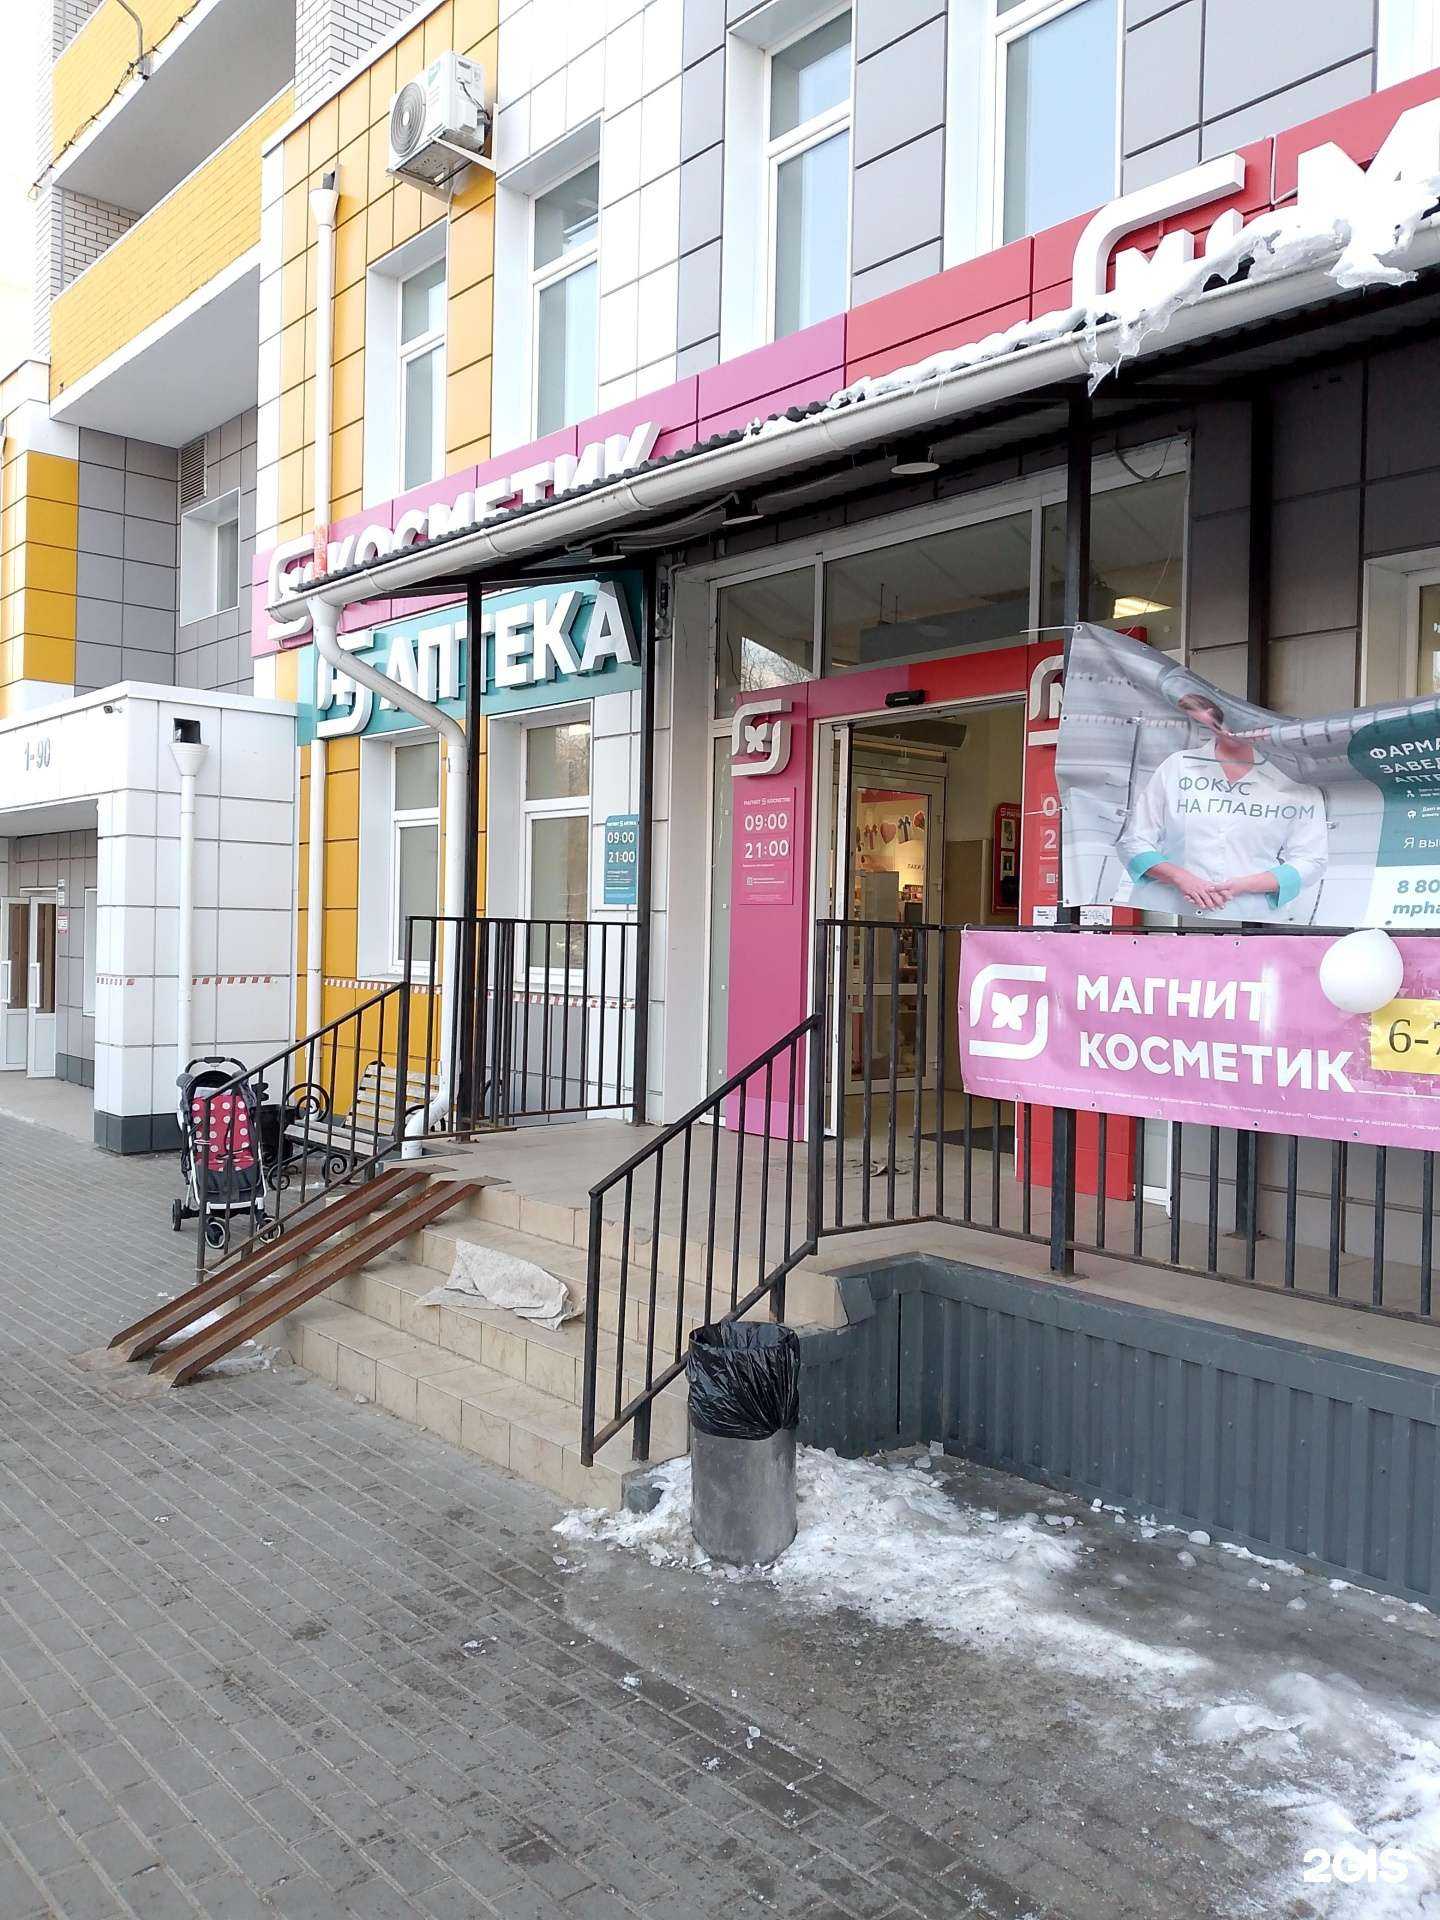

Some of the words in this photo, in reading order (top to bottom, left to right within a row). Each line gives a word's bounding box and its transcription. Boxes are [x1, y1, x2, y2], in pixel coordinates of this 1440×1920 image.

[379, 580, 640, 711] АПТЕКА
[25, 737, 50, 771] 1-90
[1178, 776, 1256, 796] ФОКУС
[1176, 798, 1201, 813] НА
[1207, 799, 1315, 819] ГЛАВНОМ
[744, 813, 787, 831] 09:00
[607, 831, 635, 844] 09:00
[1403, 836, 1415, 849] Я
[1419, 839, 1440, 849] вы
[608, 851, 636, 863] 21:00
[744, 840, 789, 859] 21:00
[1397, 880, 1409, 894] 8
[1077, 974, 1270, 1022] МАГНИТ
[1079, 1031, 1358, 1093] КОСМЕТИК
